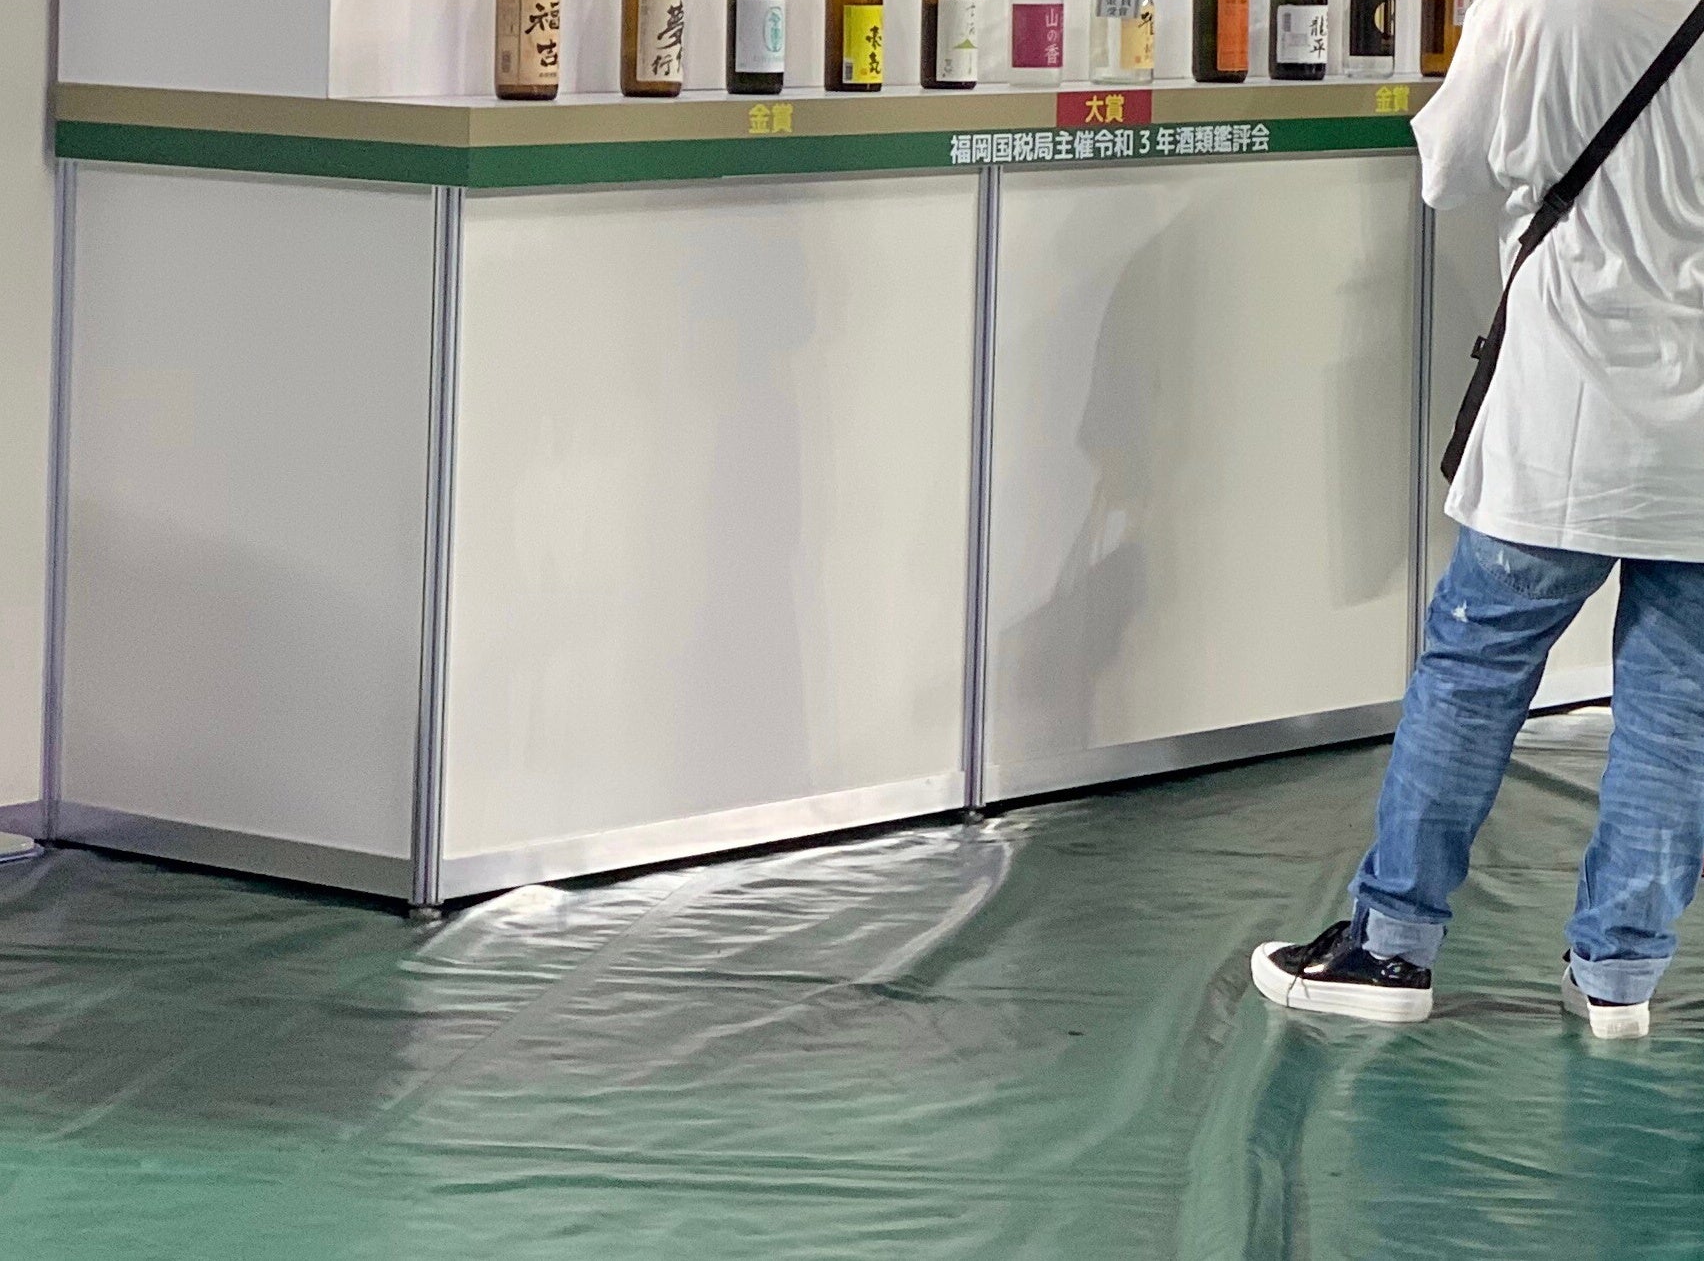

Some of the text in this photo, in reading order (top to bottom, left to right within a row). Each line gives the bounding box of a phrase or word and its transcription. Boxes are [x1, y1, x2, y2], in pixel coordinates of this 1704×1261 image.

[1085, 94, 1125, 123] 大賞
[1375, 85, 1410, 115] 金賞
[748, 103, 794, 134] 金賞
[949, 123, 1271, 165] 福岡国税局主催令和3年酒類鑑評会
